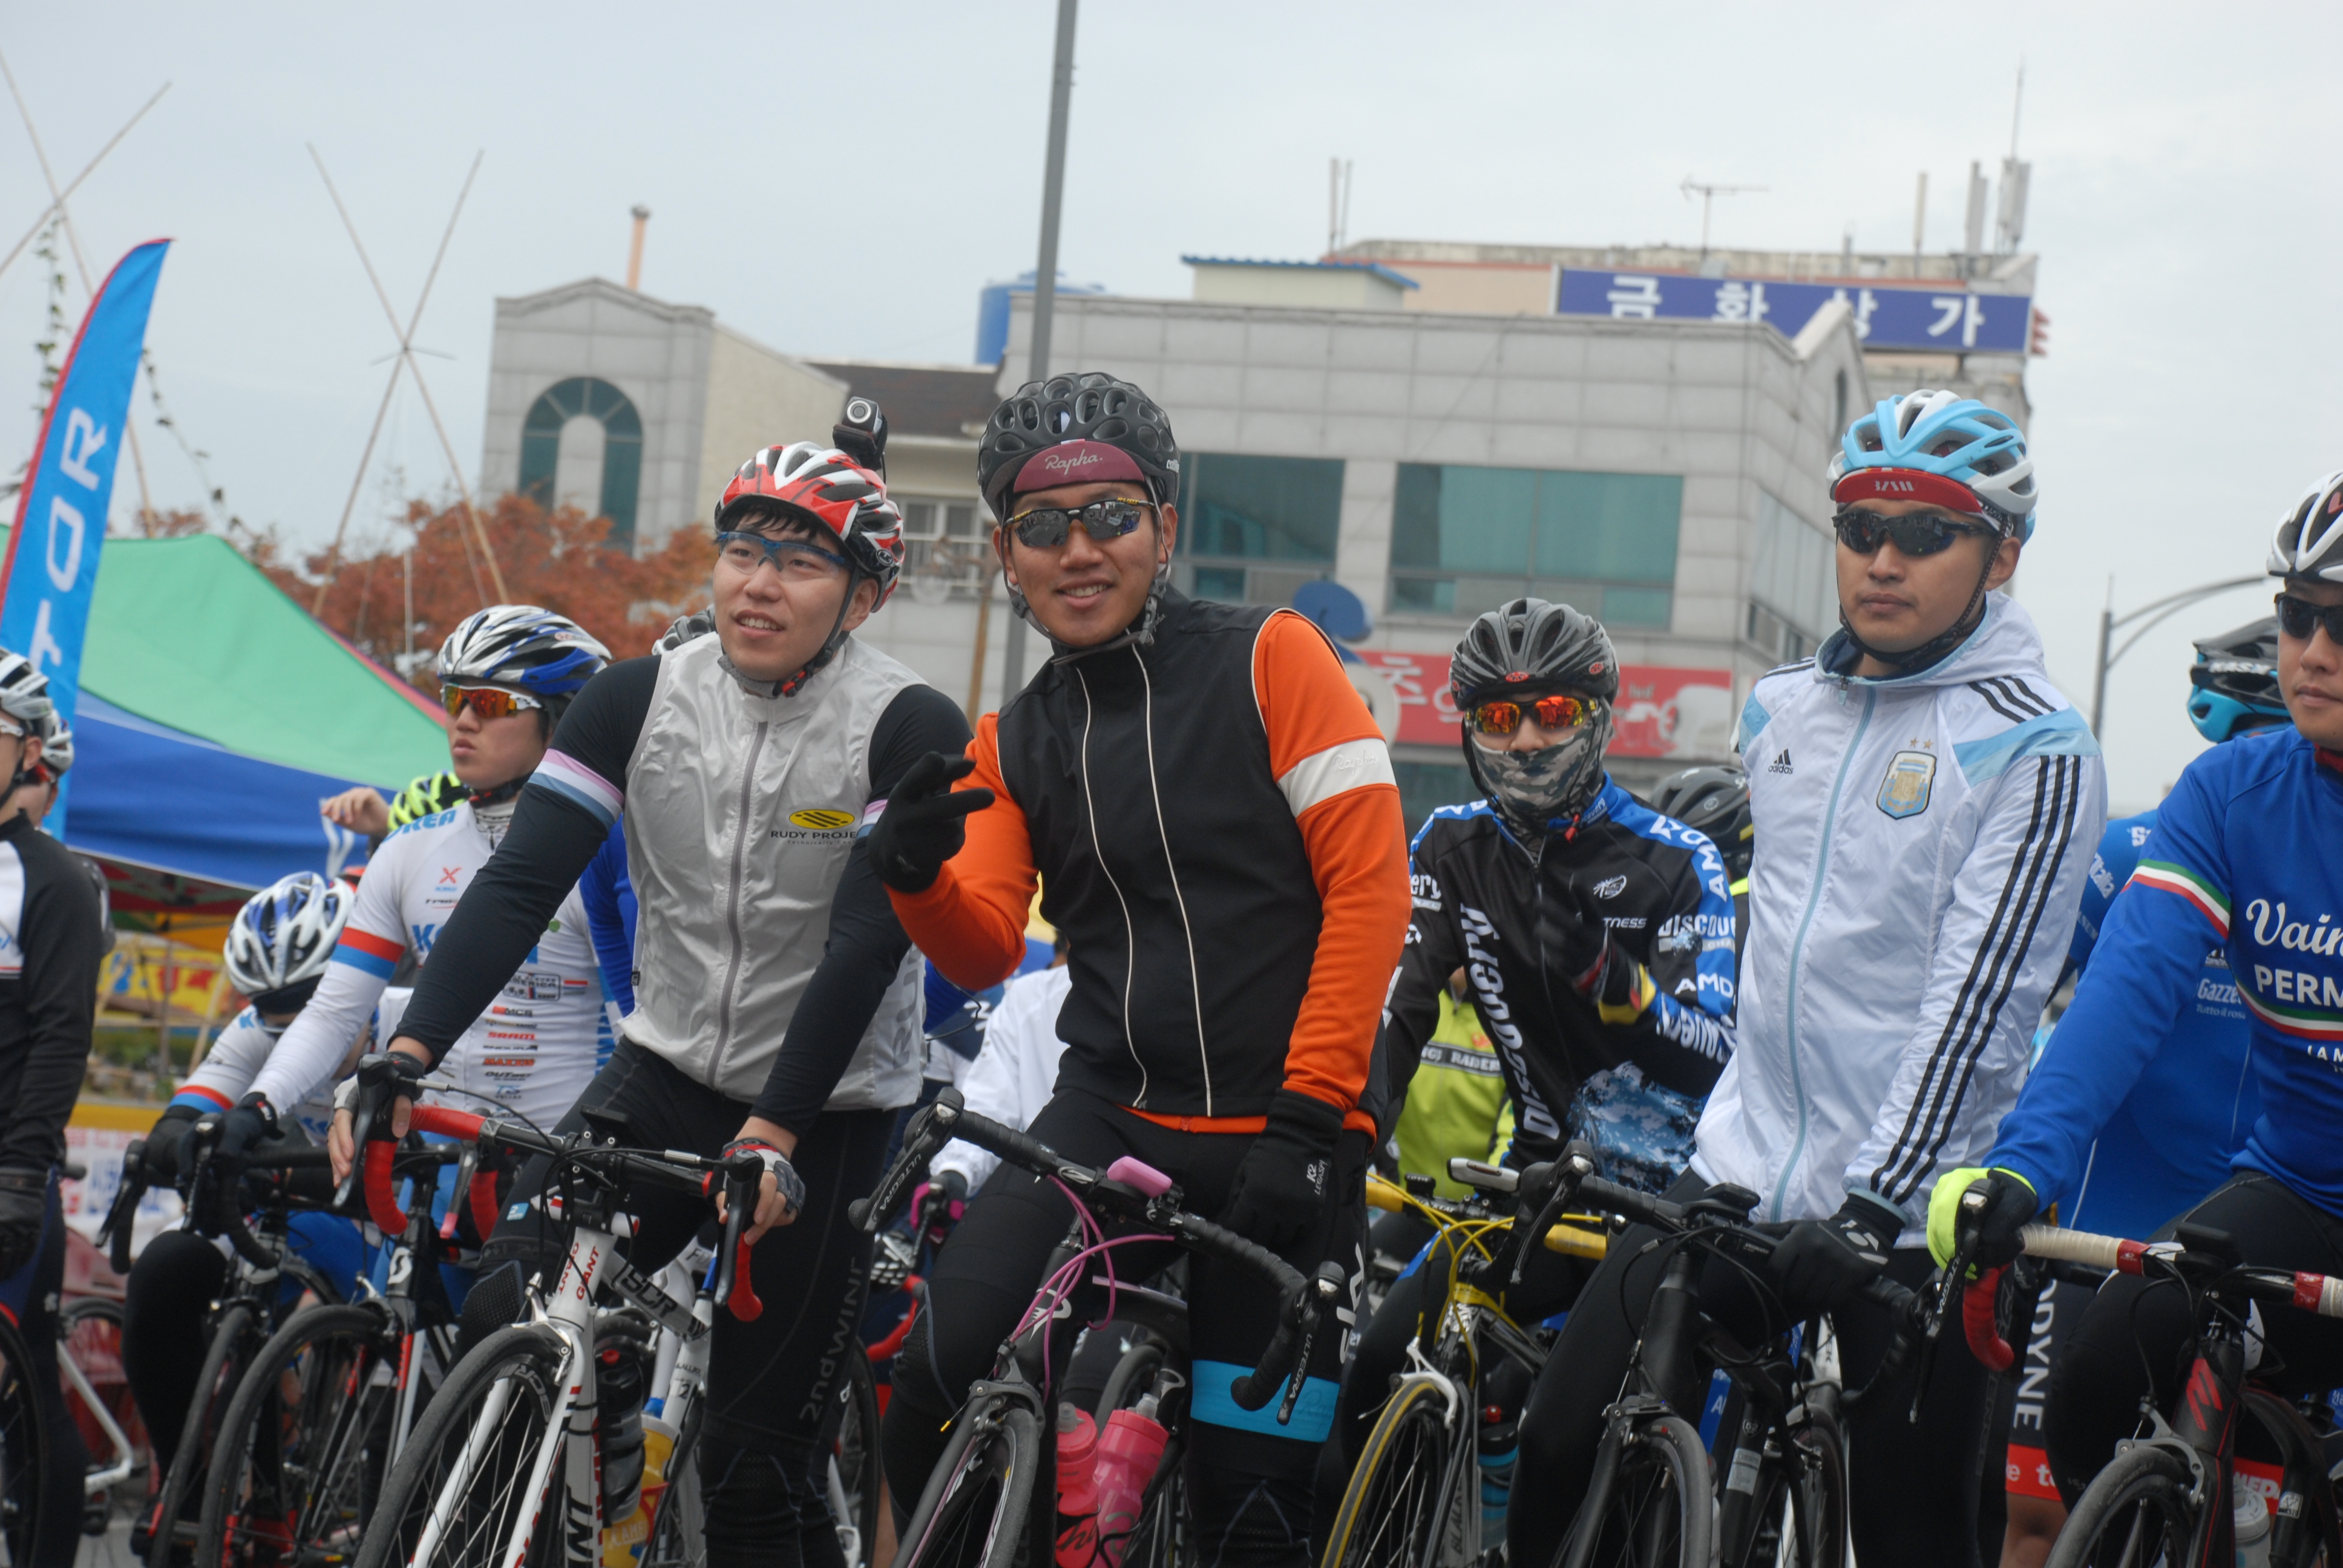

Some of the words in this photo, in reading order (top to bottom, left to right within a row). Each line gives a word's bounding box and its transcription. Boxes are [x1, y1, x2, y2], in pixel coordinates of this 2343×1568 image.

[1768, 763, 1794, 775] adidas
[770, 831, 808, 840] RUDY
[1409, 874, 1442, 900] ery
[1674, 972, 1734, 998] AMD
[879, 1153, 922, 1210] ULTEGRA
[1289, 1333, 1312, 1399] ULTEGRA
